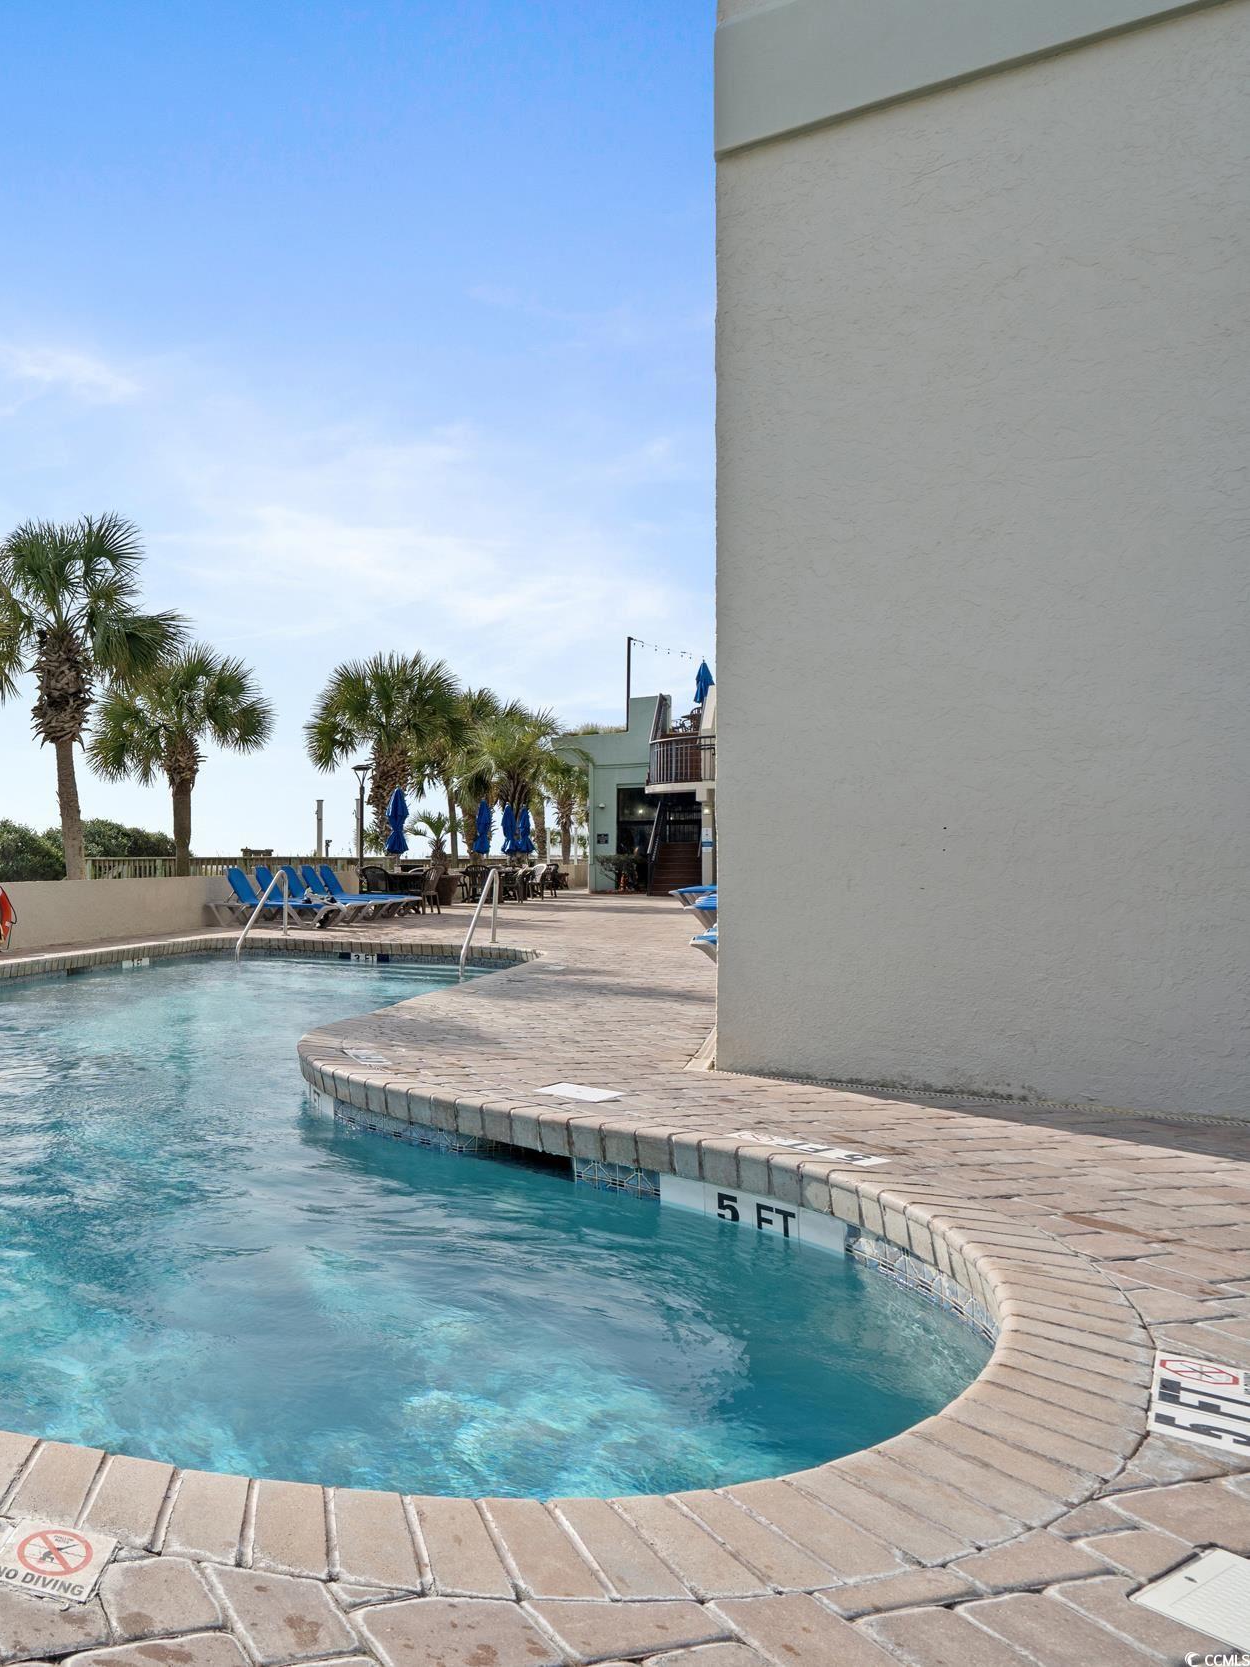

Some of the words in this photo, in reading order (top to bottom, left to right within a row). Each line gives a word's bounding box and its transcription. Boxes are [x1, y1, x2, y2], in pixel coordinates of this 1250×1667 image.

[717, 1192, 739, 1222] 5
[756, 1202, 796, 1238] FT
[21, 1572, 84, 1596] DIVING
